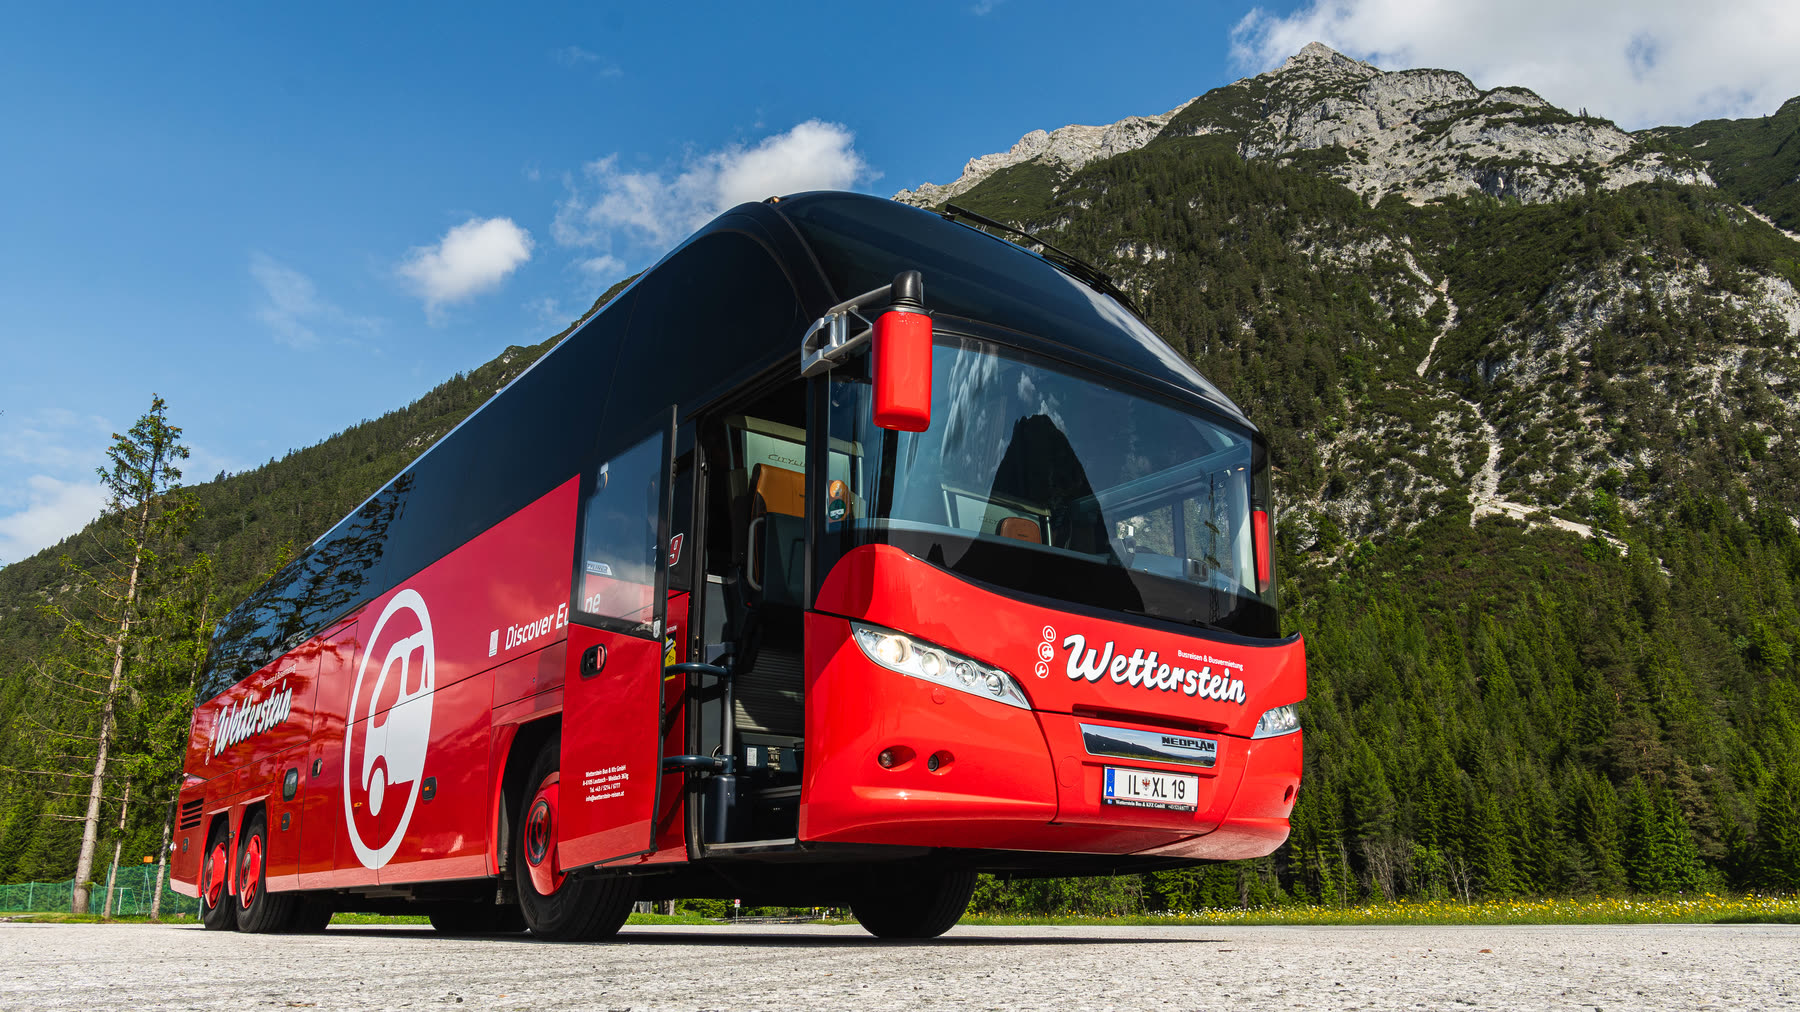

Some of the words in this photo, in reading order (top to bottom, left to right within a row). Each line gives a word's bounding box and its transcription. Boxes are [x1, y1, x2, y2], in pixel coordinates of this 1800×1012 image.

[768, 454, 806, 467] CITYLI
[505, 613, 555, 651] Discover
[1063, 634, 1246, 705] Wetterstein
[1177, 650, 1202, 661] Busreisen
[1208, 656, 1244, 672] Busvermietung
[214, 678, 293, 758] Wetterstein
[1162, 736, 1216, 752] NEOPLAN
[1107, 785, 1113, 793] A
[1128, 774, 1140, 795] IL
[1152, 776, 1167, 798] XL
[1171, 779, 1186, 799] 19
